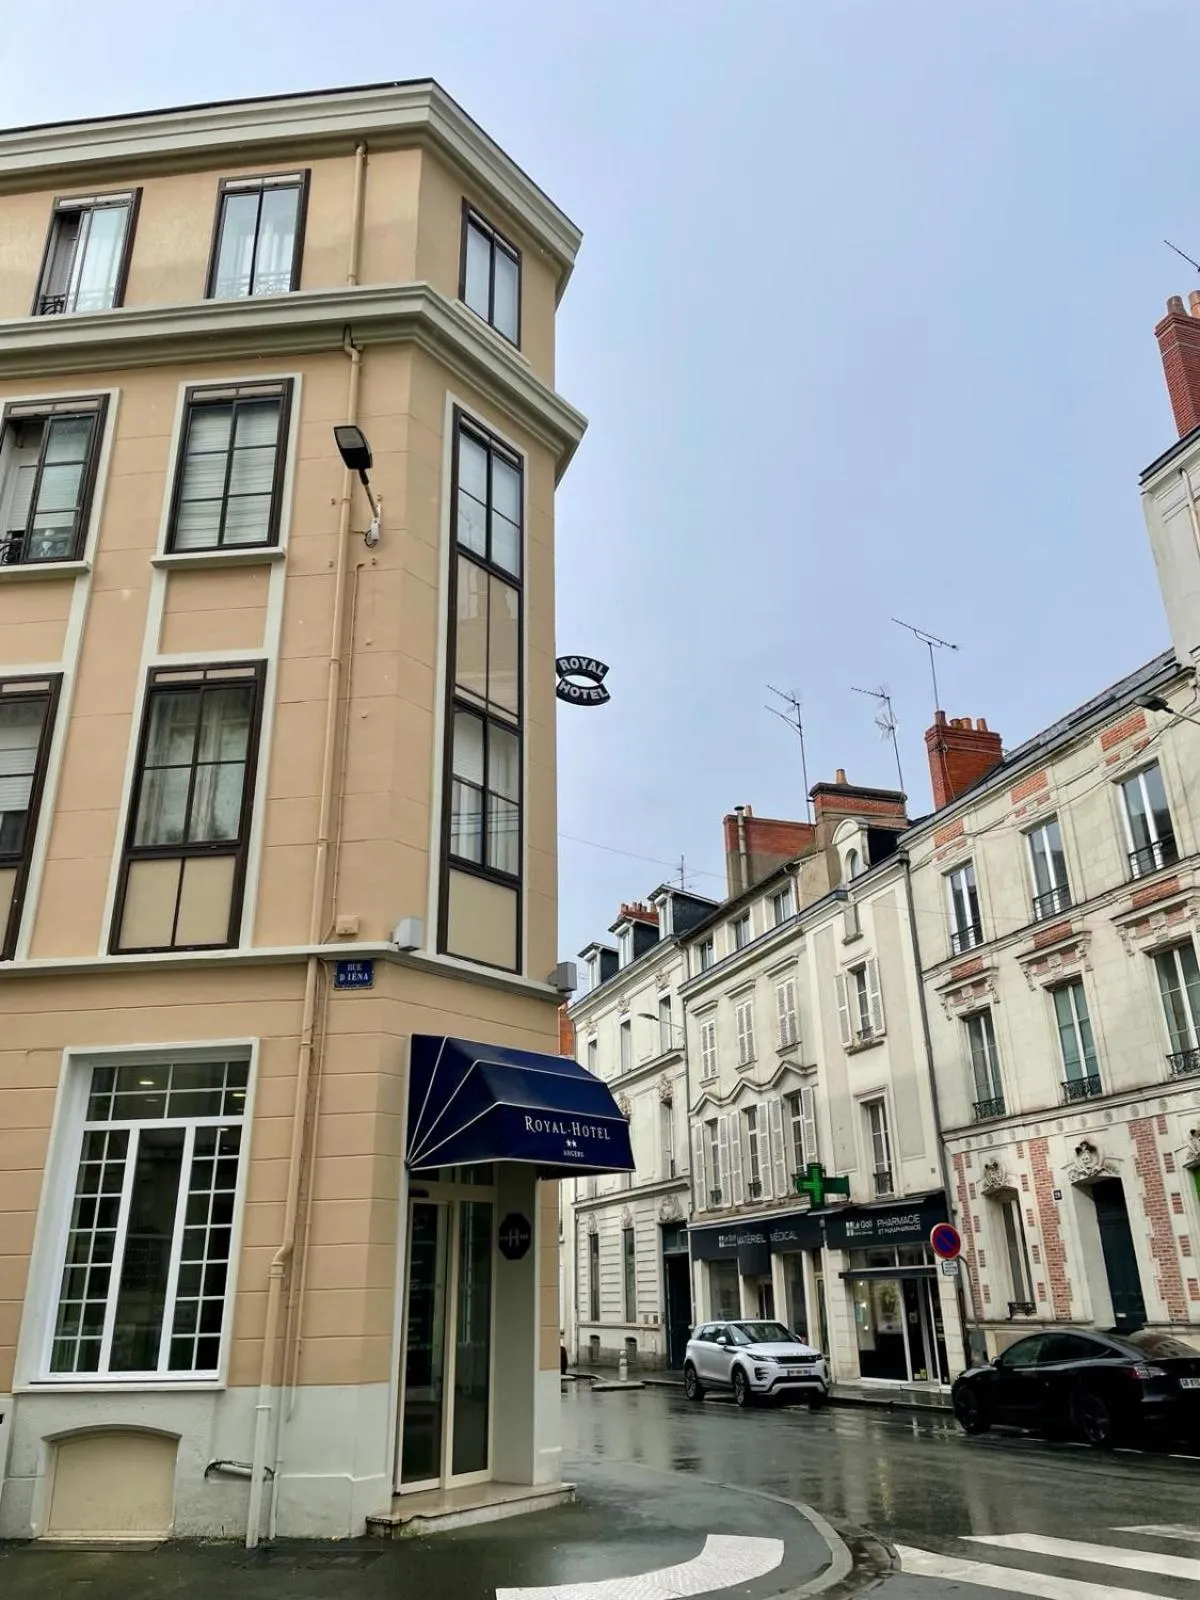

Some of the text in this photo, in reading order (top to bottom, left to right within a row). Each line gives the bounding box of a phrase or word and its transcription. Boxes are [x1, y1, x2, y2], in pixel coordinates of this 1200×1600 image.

[559, 657, 604, 676] ROYAL
[558, 681, 609, 700] HOTEL
[347, 963, 362, 971] RUE
[563, 1150, 585, 1158] ANGERS
[877, 1213, 921, 1229] PHARMACIE
[770, 1228, 798, 1242] MÉDICAL
